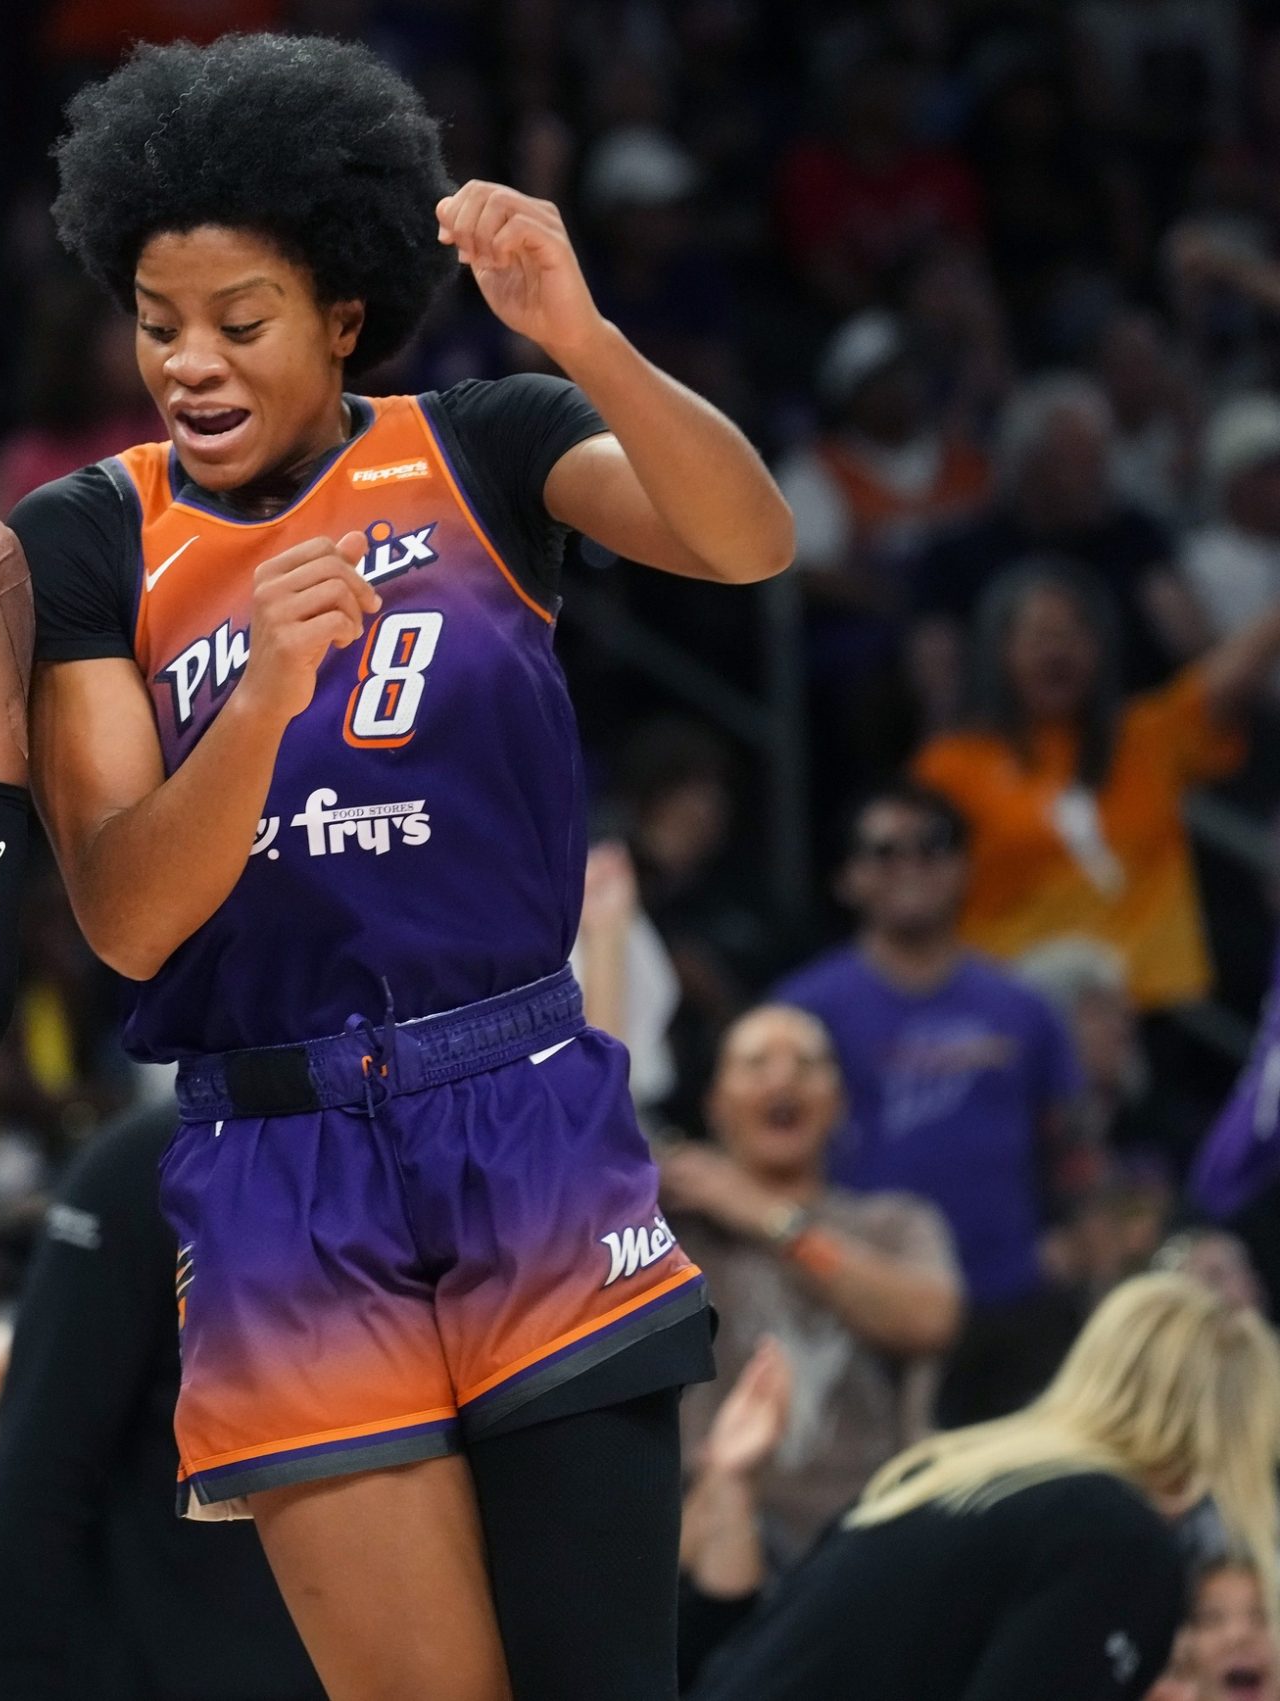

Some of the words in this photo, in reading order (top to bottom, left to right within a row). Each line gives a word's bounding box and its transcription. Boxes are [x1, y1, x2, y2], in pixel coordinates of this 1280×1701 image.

[347, 609, 444, 742] 8
[290, 787, 432, 857] fry's
[332, 808, 365, 820] FOOD
[369, 802, 415, 816] STORES
